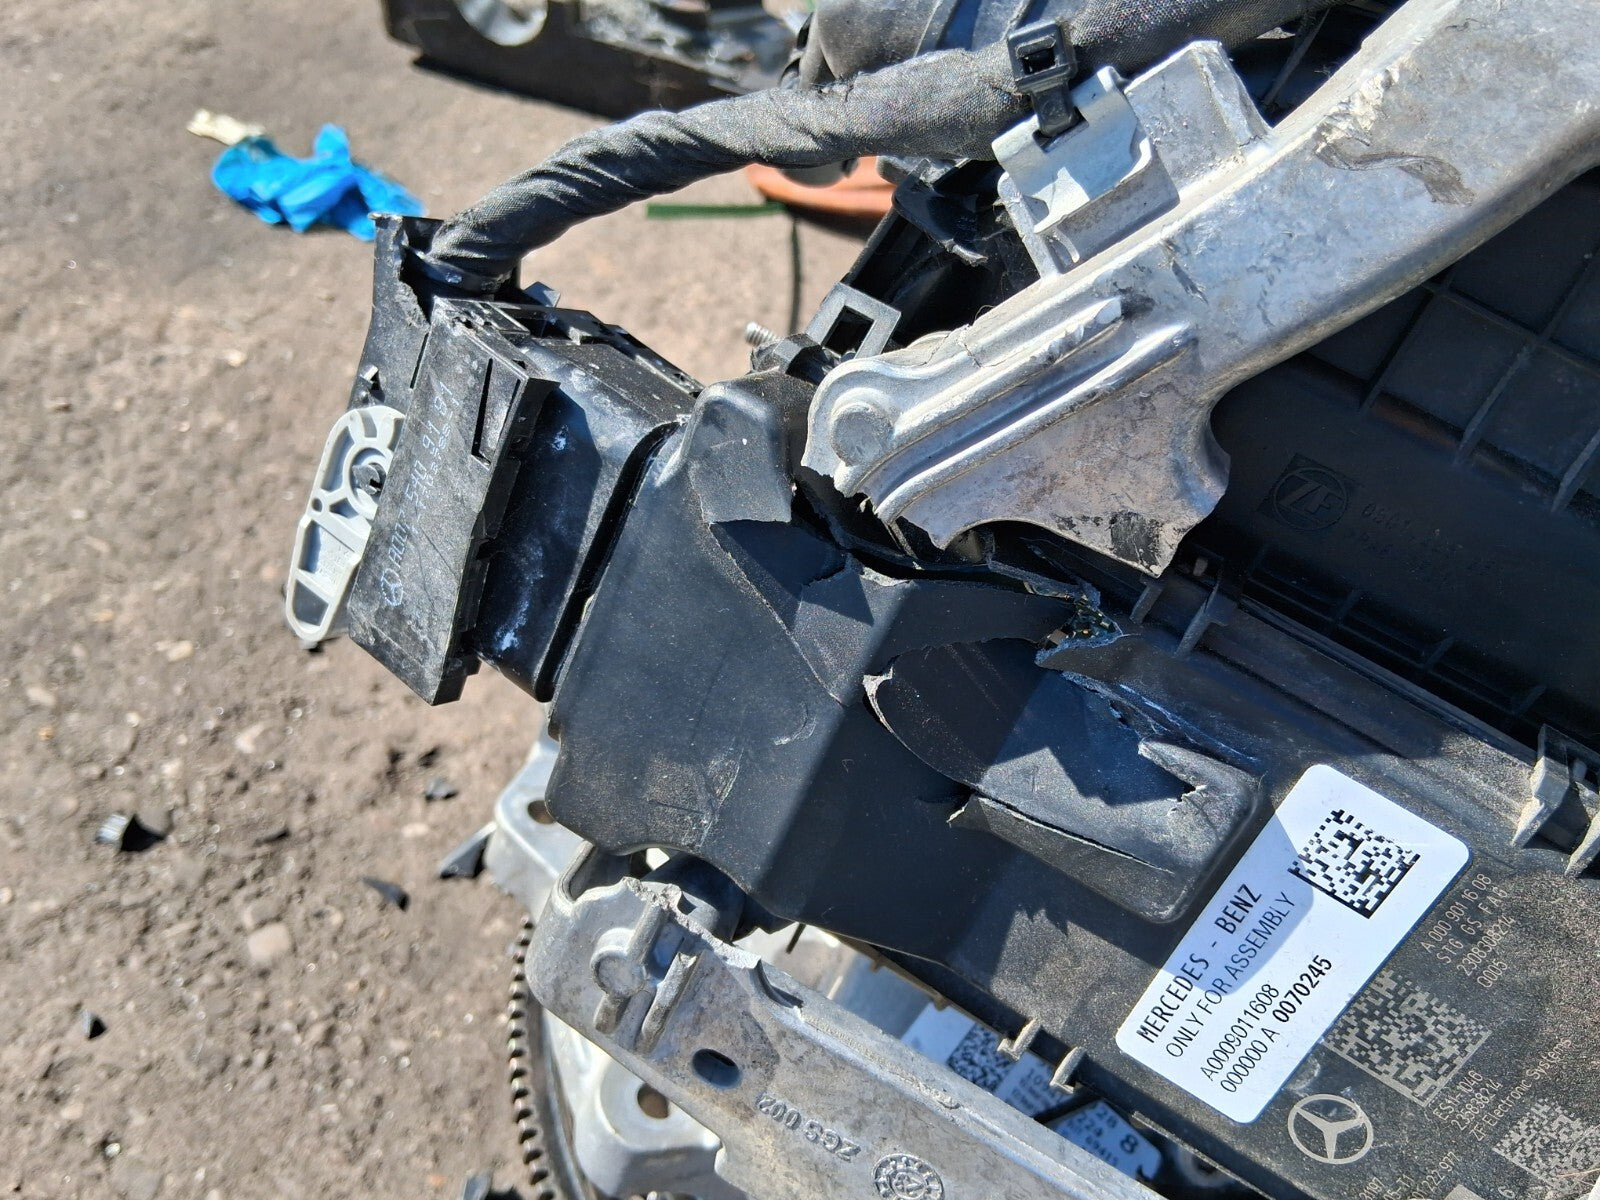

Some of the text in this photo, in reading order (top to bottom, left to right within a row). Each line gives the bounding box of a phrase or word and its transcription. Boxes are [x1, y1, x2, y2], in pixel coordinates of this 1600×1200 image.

[1421, 874, 1491, 953] A 000 901 16 08
[1437, 938, 1464, 964] STG
[1461, 917, 1482, 935] GS
[1136, 953, 1209, 1043] MERCEDES
[1214, 884, 1262, 934] BENZ
[1166, 891, 1295, 1057] ONLY FOR ASSEMBLY
[1477, 959, 1507, 988] 0005
[1200, 983, 1279, 1081] A0009011608
[1220, 954, 1332, 1092] 000000 A 0070245
[1469, 1038, 1572, 1142] ZF Electronic Systems
[1439, 1151, 1461, 1172] 977
